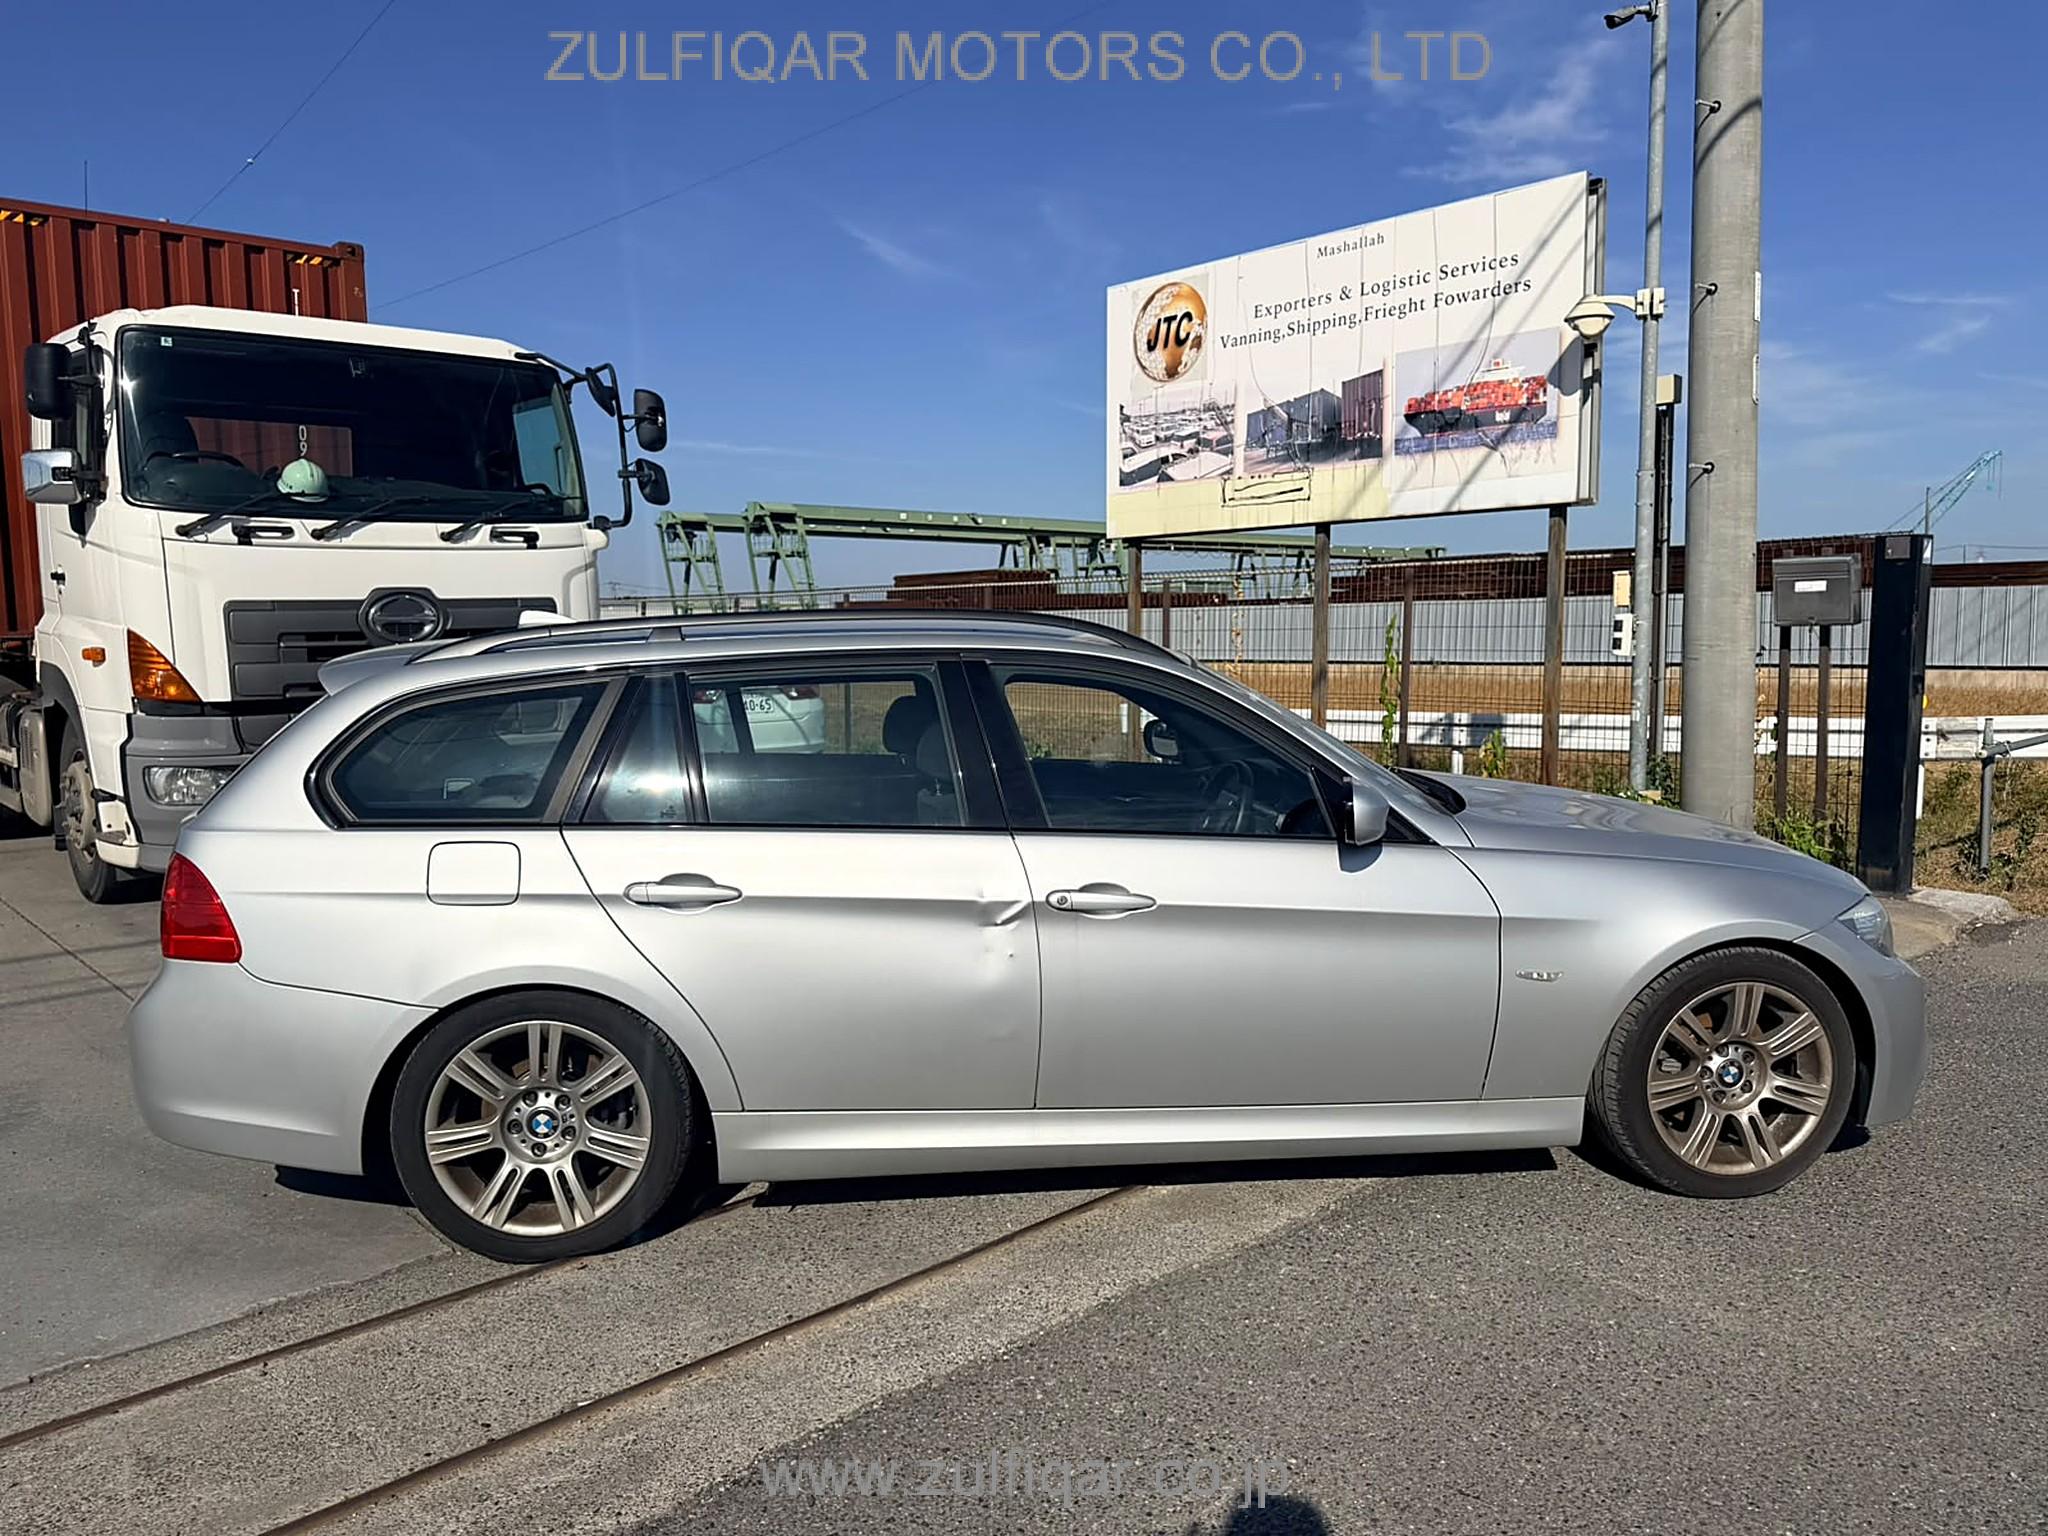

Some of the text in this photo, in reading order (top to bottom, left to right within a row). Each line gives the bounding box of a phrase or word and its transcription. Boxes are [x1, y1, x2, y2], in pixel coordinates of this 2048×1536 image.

[1316, 233, 1385, 258] Mashallah
[1253, 253, 1520, 319] Exporters & Logistic Services
[1433, 279, 1532, 308] Fowarders
[1146, 311, 1193, 352] JTC
